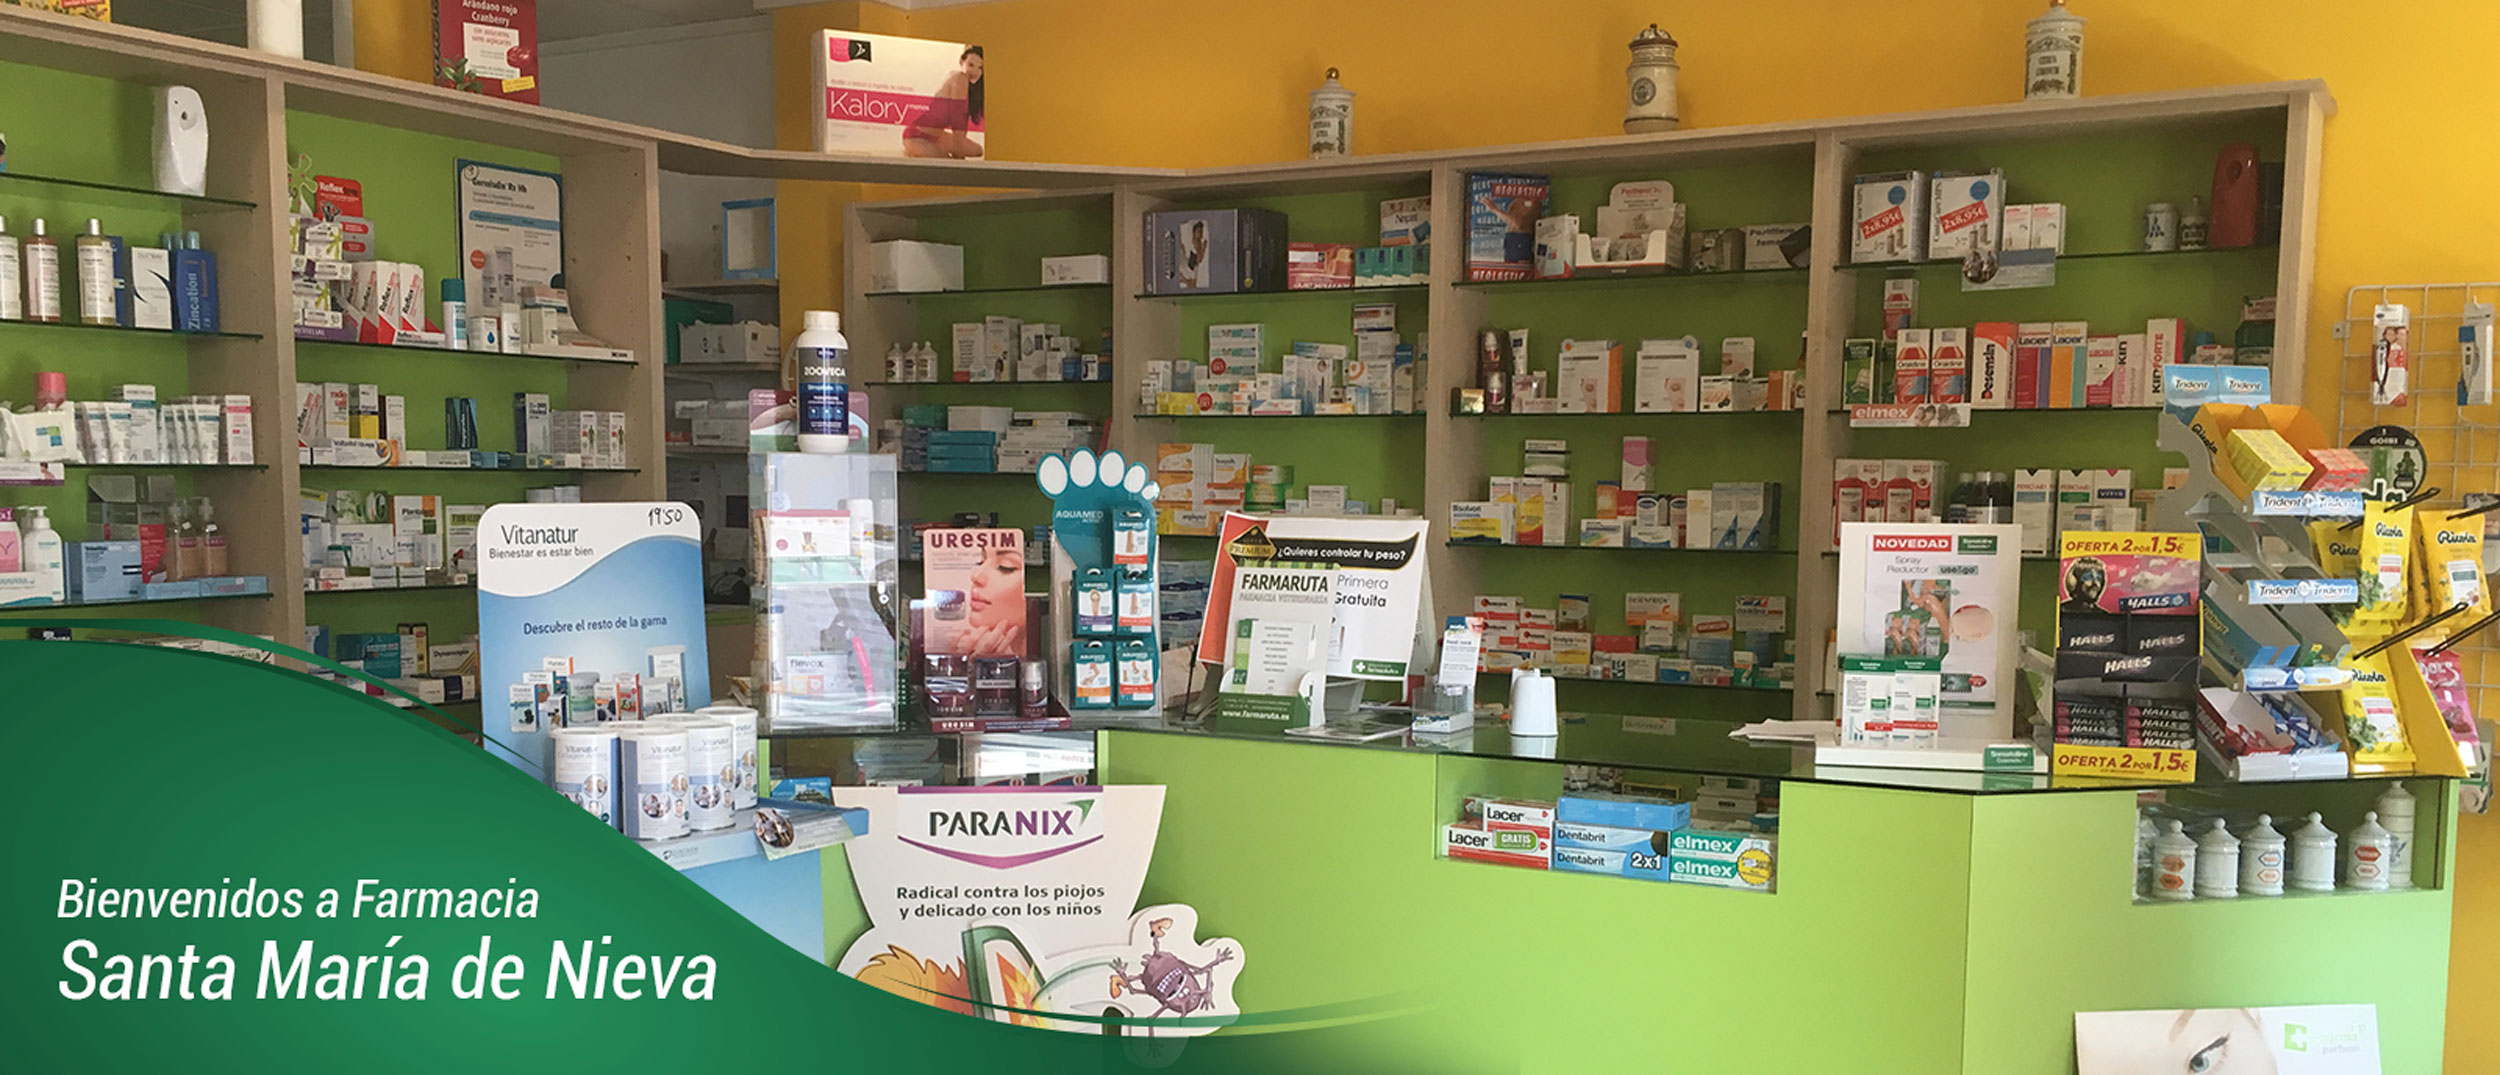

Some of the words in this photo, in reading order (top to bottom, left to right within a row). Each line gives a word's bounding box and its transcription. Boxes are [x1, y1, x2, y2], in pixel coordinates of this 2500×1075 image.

[471, 11, 510, 27] Cranberry
[830, 90, 909, 125] Kalory
[187, 272, 200, 330] Zincation
[2018, 336, 2049, 346] Lacer
[2053, 335, 2084, 345] Lacer
[1981, 343, 1996, 400] Desensin
[2174, 378, 2209, 391] Trident
[2228, 378, 2262, 391] Trident
[1856, 406, 1909, 419] elmex
[2263, 495, 2303, 508] Trident
[2318, 497, 2357, 509] Trident
[1055, 510, 1104, 519] AQUAMED
[500, 524, 579, 546] Vitanatur
[2374, 521, 2404, 538] Ricola
[1875, 537, 1950, 549] NOVEDAD
[2065, 540, 2120, 552] OFERTA
[2121, 538, 2134, 552] 2
[2436, 530, 2478, 545] Ricola
[488, 547, 535, 560] Bienestar
[536, 549, 548, 559] es
[549, 548, 573, 558] estar
[574, 546, 595, 557] bien
[1276, 546, 1319, 558] ¿Quieres
[1319, 546, 1363, 559] controlar
[1363, 548, 1374, 559] tu
[1374, 550, 1406, 562] peso?
[2328, 542, 2360, 557] Rico
[1894, 555, 1923, 567] Spray
[1241, 573, 1330, 593] FARMARUTA
[1336, 573, 1390, 590] Primera
[2259, 584, 2298, 597] Trident
[2313, 584, 2352, 596] Trident
[1334, 591, 1388, 608] Gratuita
[2127, 596, 2172, 610] HALLS
[522, 619, 574, 636] Descubre
[575, 618, 586, 632] el
[586, 618, 614, 631] resto
[614, 616, 628, 629] de
[629, 614, 639, 628] la
[640, 617, 668, 629] gama
[2069, 633, 2116, 648] HALLS
[2138, 633, 2186, 651] HALLS
[789, 657, 825, 669] flevox
[2103, 655, 2153, 674] HALLS
[2352, 668, 2388, 683] Ricola
[1221, 708, 1291, 722] www.farmaruta.es
[2141, 707, 2179, 719] HALLS
[2071, 724, 2107, 733] HALLS
[2141, 718, 2179, 729] HALLS
[2142, 737, 2181, 748] HALLS
[2058, 753, 2118, 768] OFERTA
[2119, 753, 2133, 769] 2
[1487, 805, 1524, 823] Lacer
[929, 809, 1075, 837] PARANIX
[1448, 829, 1489, 848] Lacer
[1500, 832, 1532, 845] GRATIS
[1557, 828, 1606, 844] Dentabrit
[1673, 834, 1735, 855] elmex
[1557, 850, 1606, 867] Dentabrit
[1630, 851, 1663, 871] 2x1
[1673, 857, 1735, 879] elmex
[896, 885, 959, 900] Radical
[963, 887, 1019, 900] contra
[1024, 885, 1049, 899] los
[1053, 883, 1106, 902] piojos
[899, 907, 910, 921] y
[914, 903, 988, 918] delicado
[991, 905, 1022, 917] con
[1026, 903, 1052, 917] los
[1055, 901, 1103, 916] niños
